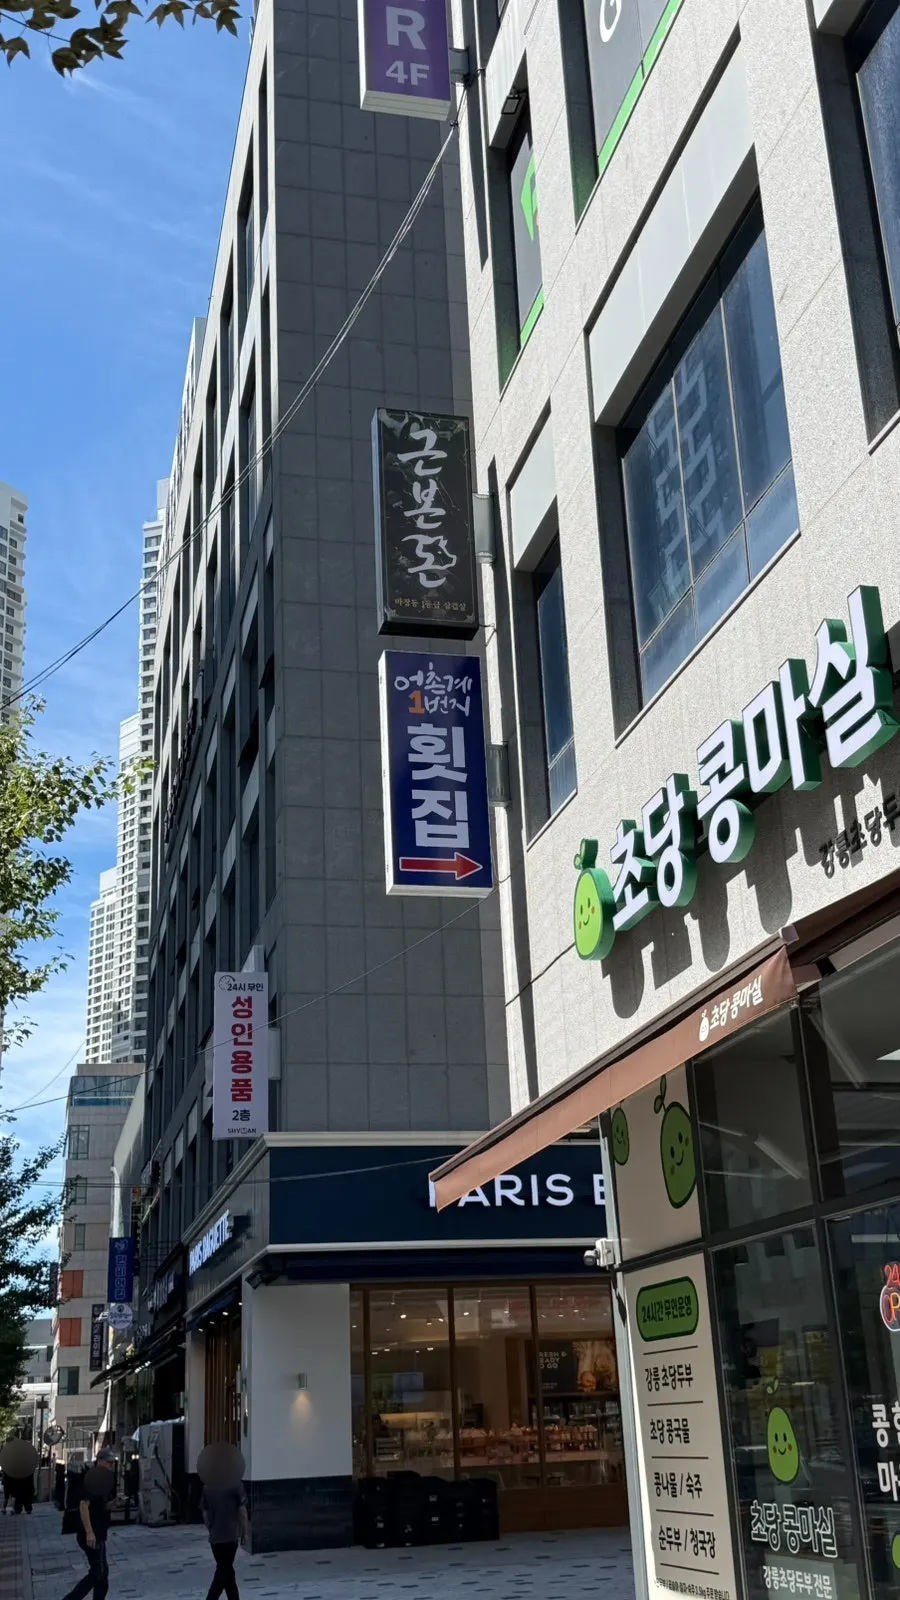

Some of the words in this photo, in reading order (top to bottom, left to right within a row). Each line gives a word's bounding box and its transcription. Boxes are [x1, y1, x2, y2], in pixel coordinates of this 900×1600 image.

[386, 0, 426, 50] R
[385, 61, 430, 86] 4F
[397, 428, 457, 588] 근본돈
[394, 662, 472, 694] 어촌계
[408, 690, 470, 717] 1번지
[407, 723, 470, 849] 횟집
[227, 983, 246, 992] 24시
[247, 983, 264, 992] 무인
[230, 996, 253, 1103] 성인용품
[232, 1109, 250, 1121] 2층
